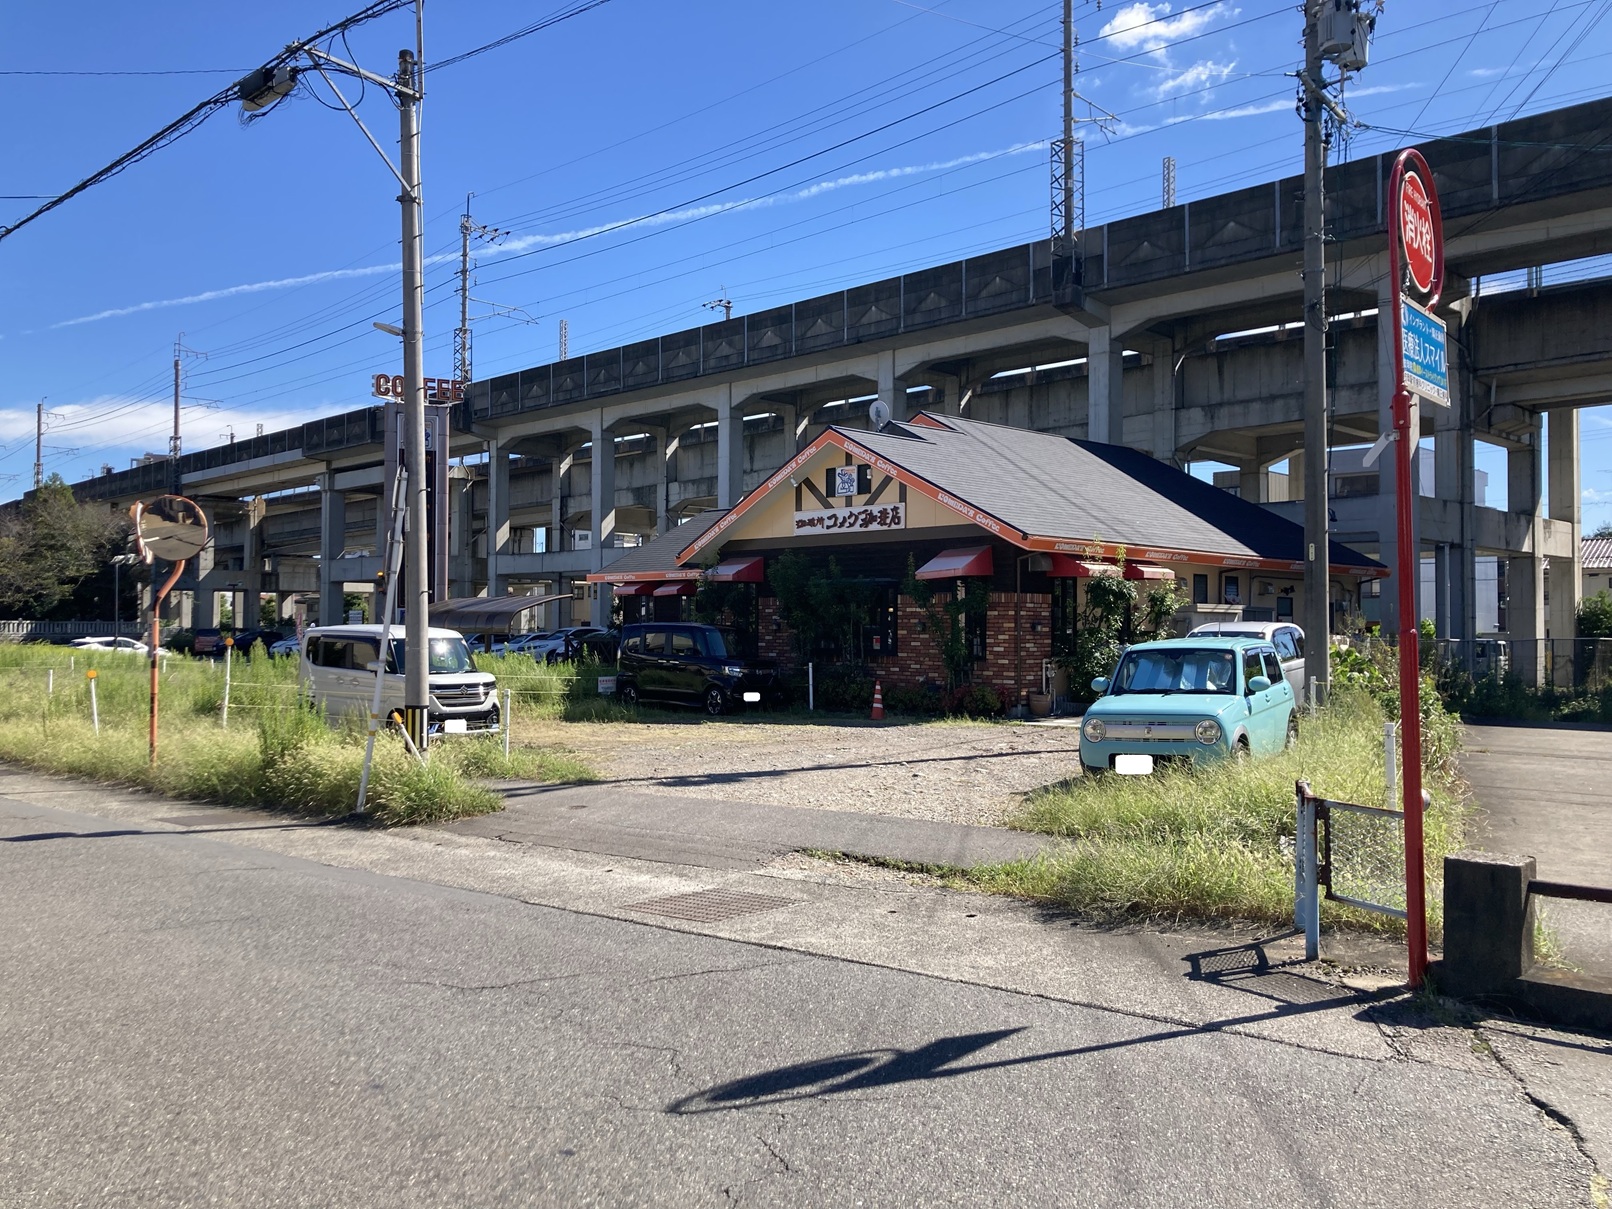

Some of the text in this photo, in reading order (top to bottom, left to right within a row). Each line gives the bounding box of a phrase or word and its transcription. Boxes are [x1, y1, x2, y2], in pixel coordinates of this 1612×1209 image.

[1403, 200, 1433, 263] 消火栓
[1402, 327, 1446, 373] 医療法人スマイル
[375, 373, 464, 401] COFEE
[796, 445, 817, 463] Coffee
[876, 459, 898, 476] Coffee
[975, 513, 1001, 532] Coffee
